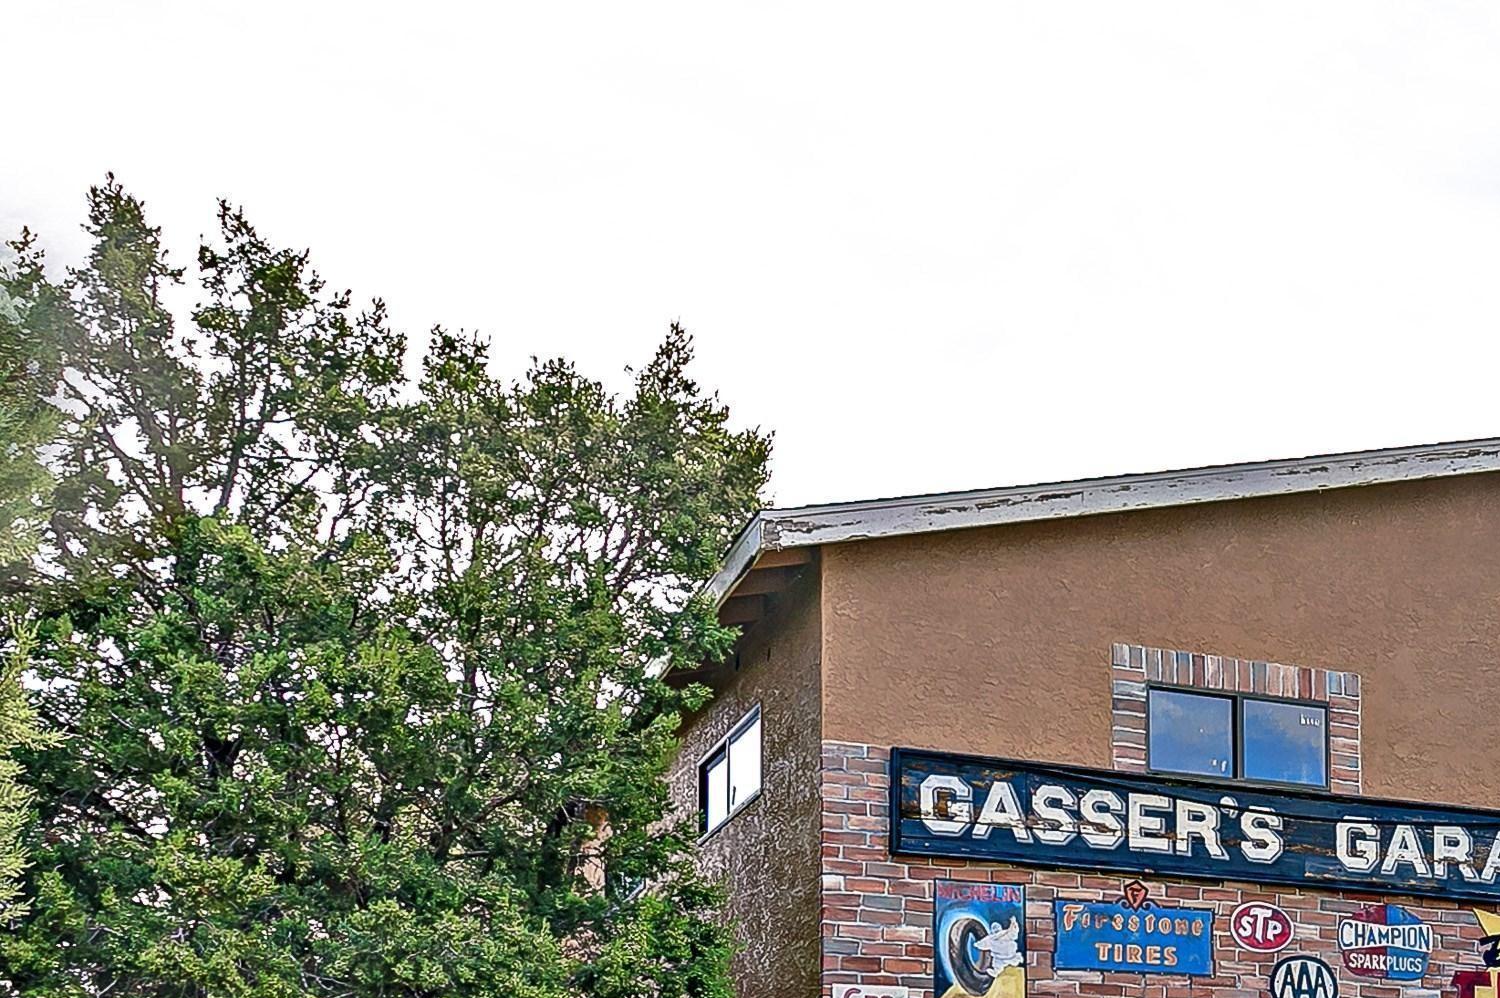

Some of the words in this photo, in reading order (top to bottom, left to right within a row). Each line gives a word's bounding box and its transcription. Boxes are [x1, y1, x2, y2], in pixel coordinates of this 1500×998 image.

[918, 773, 1285, 865] GASSER'S
[937, 883, 1021, 903] MICHELIN
[1063, 904, 1204, 936] Firestone
[1238, 907, 1283, 944] STP
[1341, 921, 1431, 951] CHAMPION
[1095, 943, 1178, 966] TIRES
